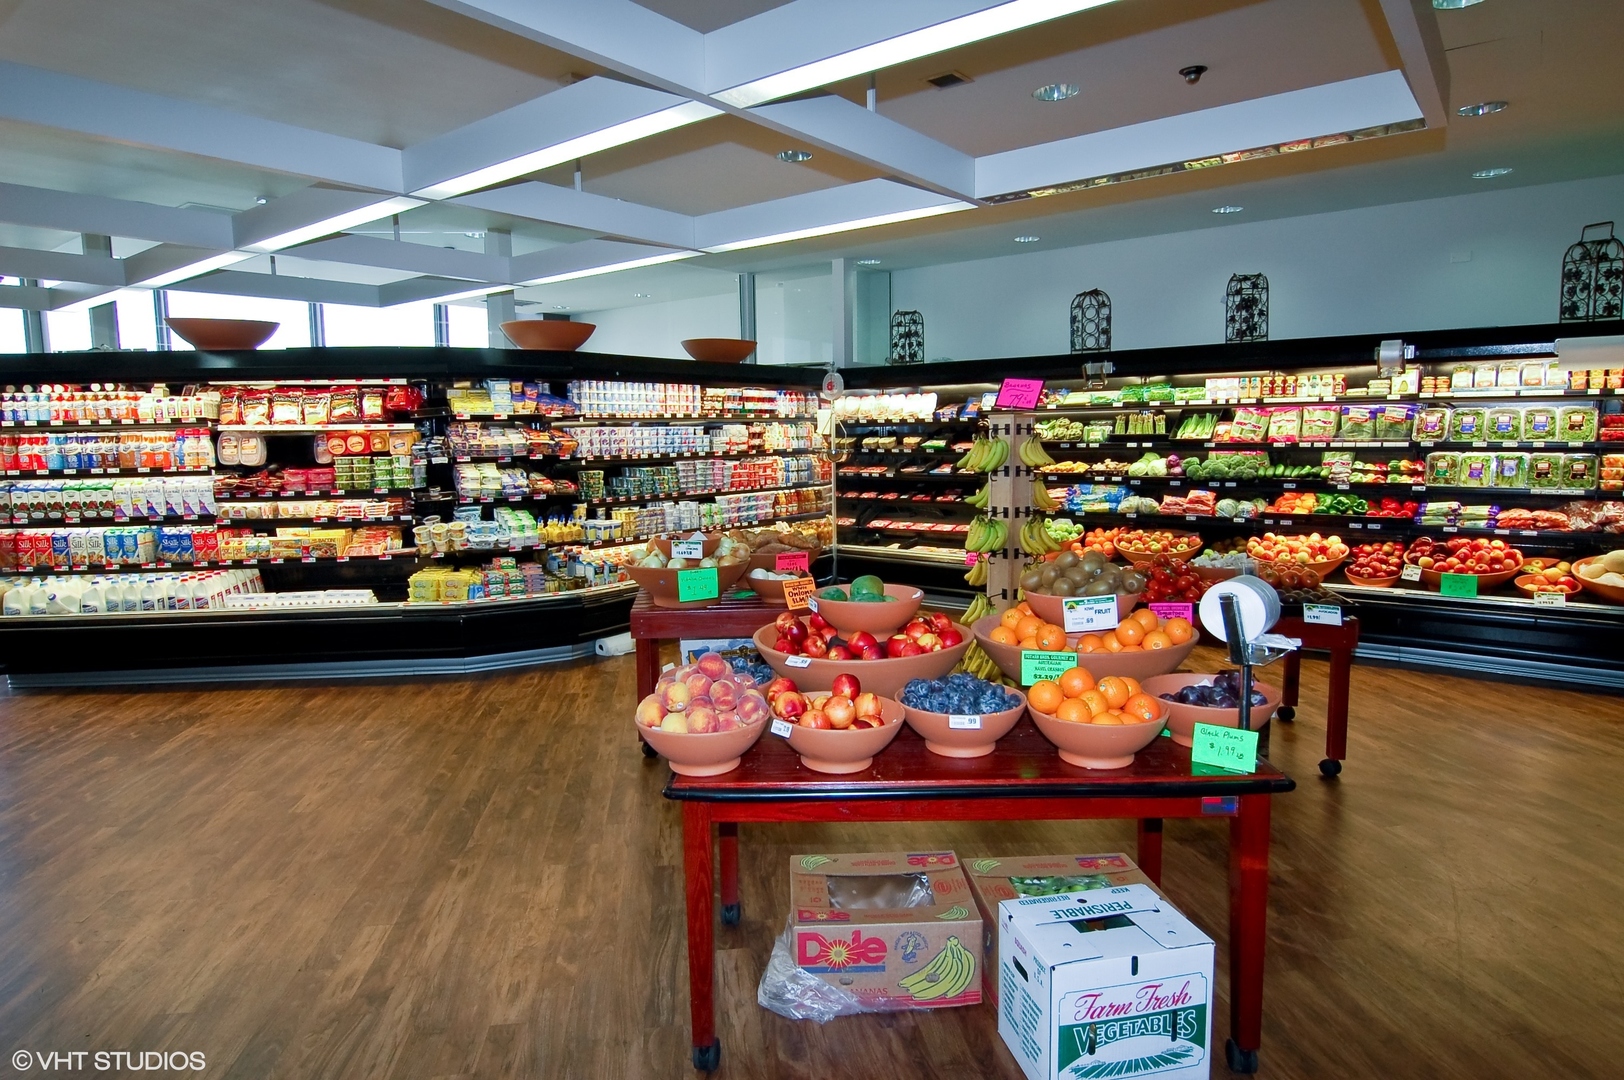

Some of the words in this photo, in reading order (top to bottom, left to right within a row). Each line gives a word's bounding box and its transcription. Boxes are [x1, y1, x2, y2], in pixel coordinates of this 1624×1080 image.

[18, 540, 32, 548] Silk
[36, 540, 50, 548] Silk
[53, 539, 67, 548] Silk
[72, 540, 84, 548] Silk
[88, 540, 102, 549] Silk
[106, 537, 118, 546] Silk
[1222, 730, 1245, 742] Plums
[1110, 886, 1130, 895] KEEP
[1018, 894, 1070, 906] REFRIGERATED
[1050, 900, 1134, 920] PERISHABLE
[798, 910, 850, 920] Dole
[798, 930, 888, 967] Dole
[849, 987, 888, 995] ANANAS
[1074, 992, 1132, 1022] Farm
[1136, 980, 1192, 1013] Fresh
[1074, 1010, 1198, 1056] VEGETABLES
